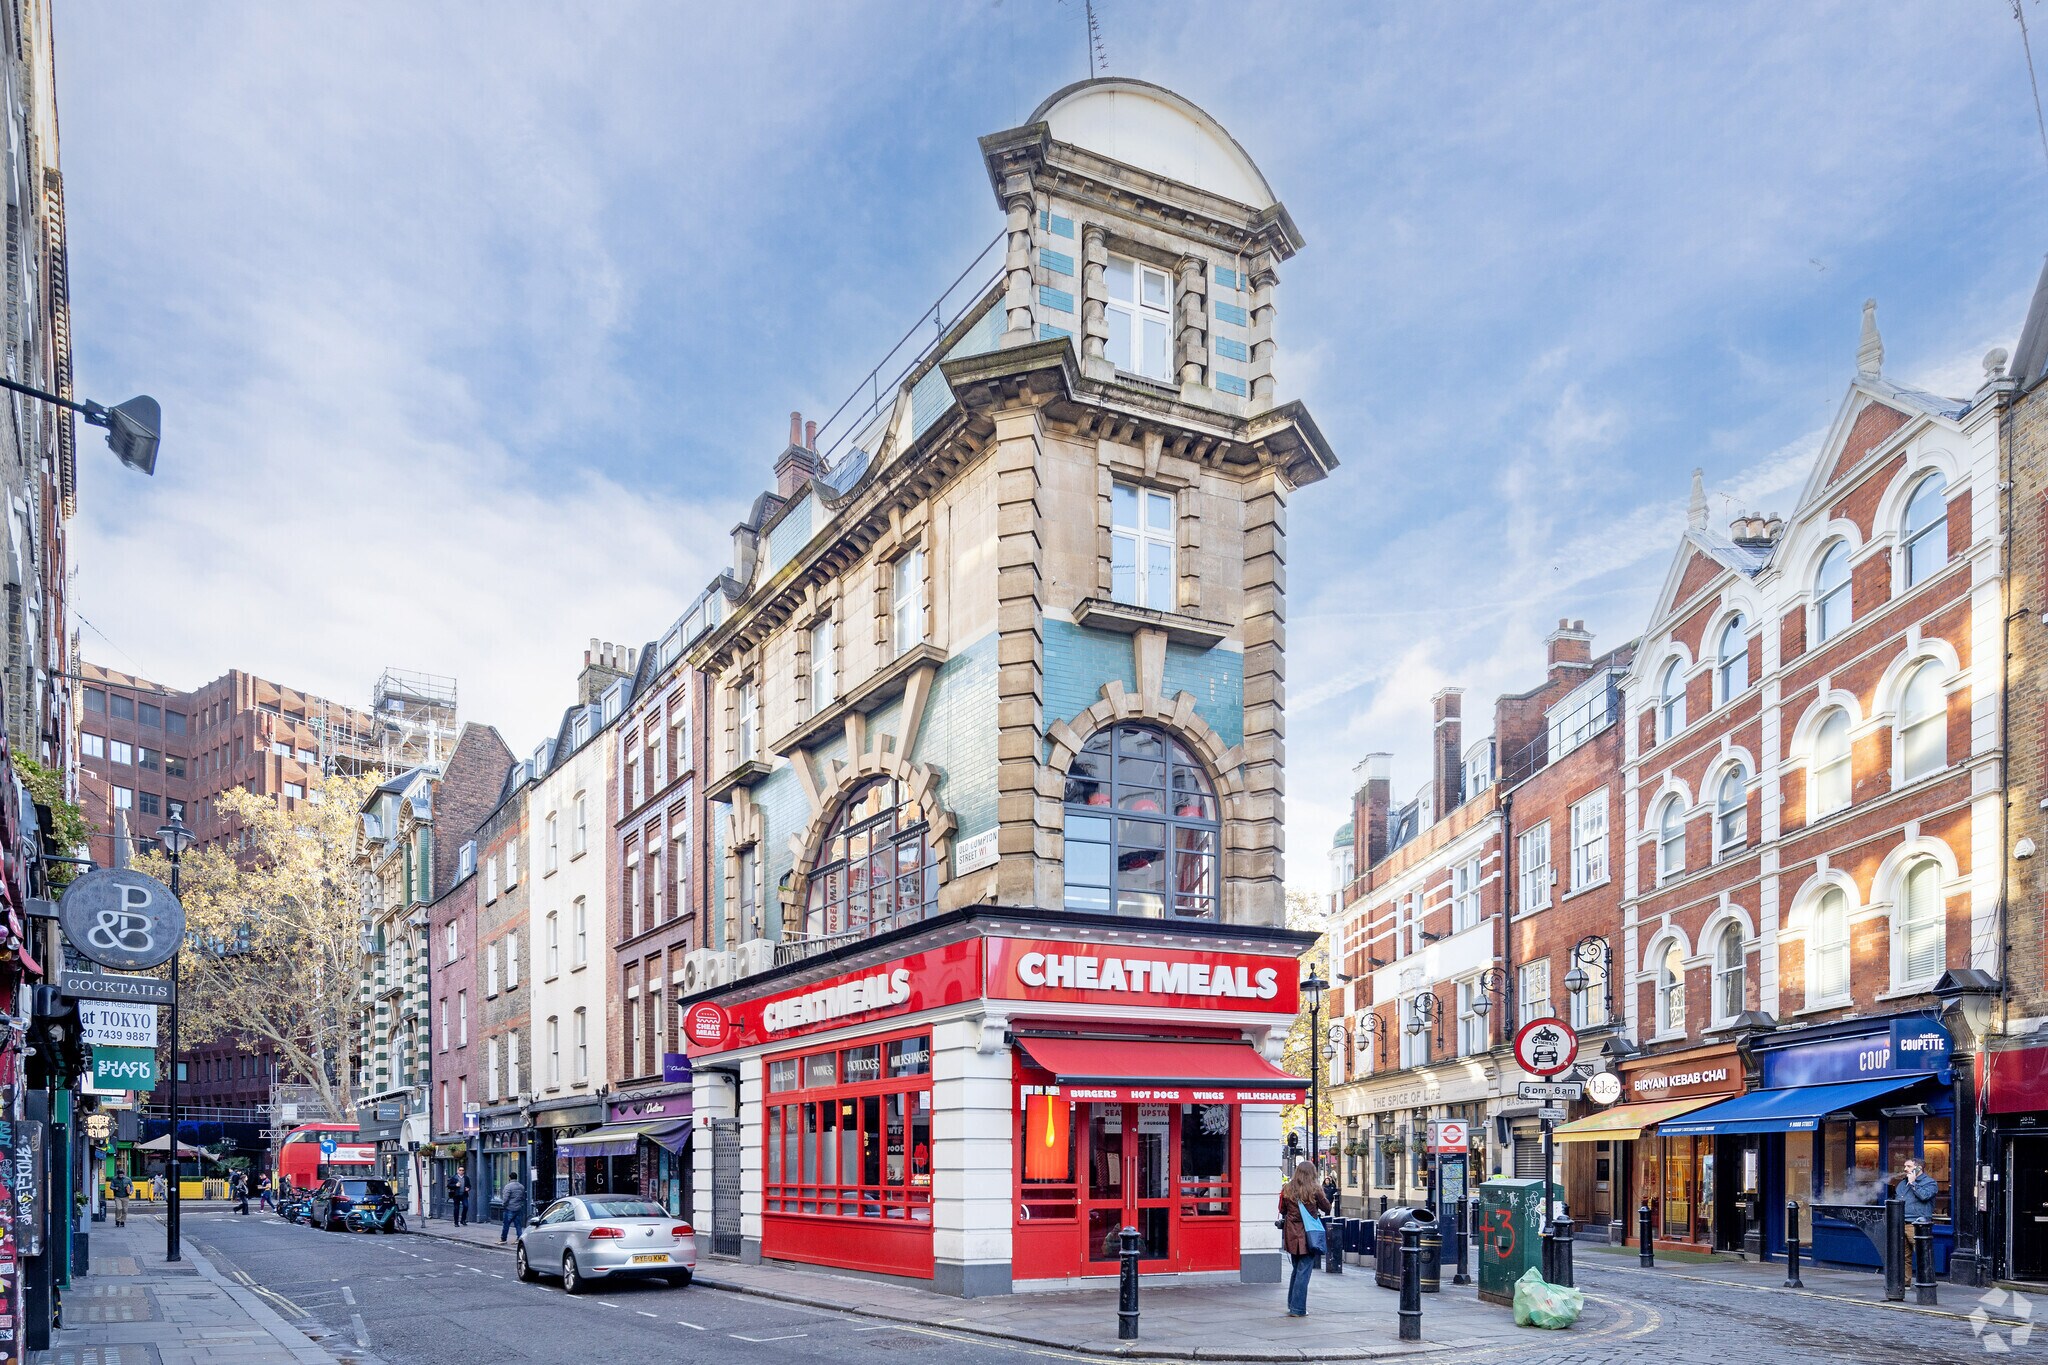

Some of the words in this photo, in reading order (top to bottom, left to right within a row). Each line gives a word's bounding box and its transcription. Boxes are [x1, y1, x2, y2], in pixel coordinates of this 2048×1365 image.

[970, 831, 998, 850] COMPTON
[958, 849, 977, 865] STREET
[1017, 951, 1278, 1000] CHEATMEALS
[67, 979, 168, 997] COCKTAILS
[763, 968, 911, 1033] CHEATMEALS
[100, 1010, 151, 1029] TOKYO
[98, 1029, 122, 1039] 7439
[126, 1031, 151, 1042] 9887
[1900, 1038, 1945, 1051] COUPETTE
[98, 1060, 150, 1070] SHACK
[890, 1050, 930, 1068] MILKSHAKES
[812, 1065, 834, 1077] WINGS
[1634, 1078, 1668, 1091] BIRYANI
[1669, 1073, 1701, 1087] KEBAB
[1702, 1068, 1727, 1082] CHAI
[1070, 1089, 1118, 1098] BURGERS
[1131, 1090, 1151, 1099] HOT
[1153, 1091, 1180, 1099] DOGS
[1192, 1092, 1225, 1100] WINGS
[1236, 1092, 1297, 1101] MILKSHAKES
[1373, 1095, 1386, 1109] THE
[1388, 1092, 1409, 1107] SPICE
[1410, 1091, 1421, 1103] OF
[1424, 1088, 1441, 1101] LIFE
